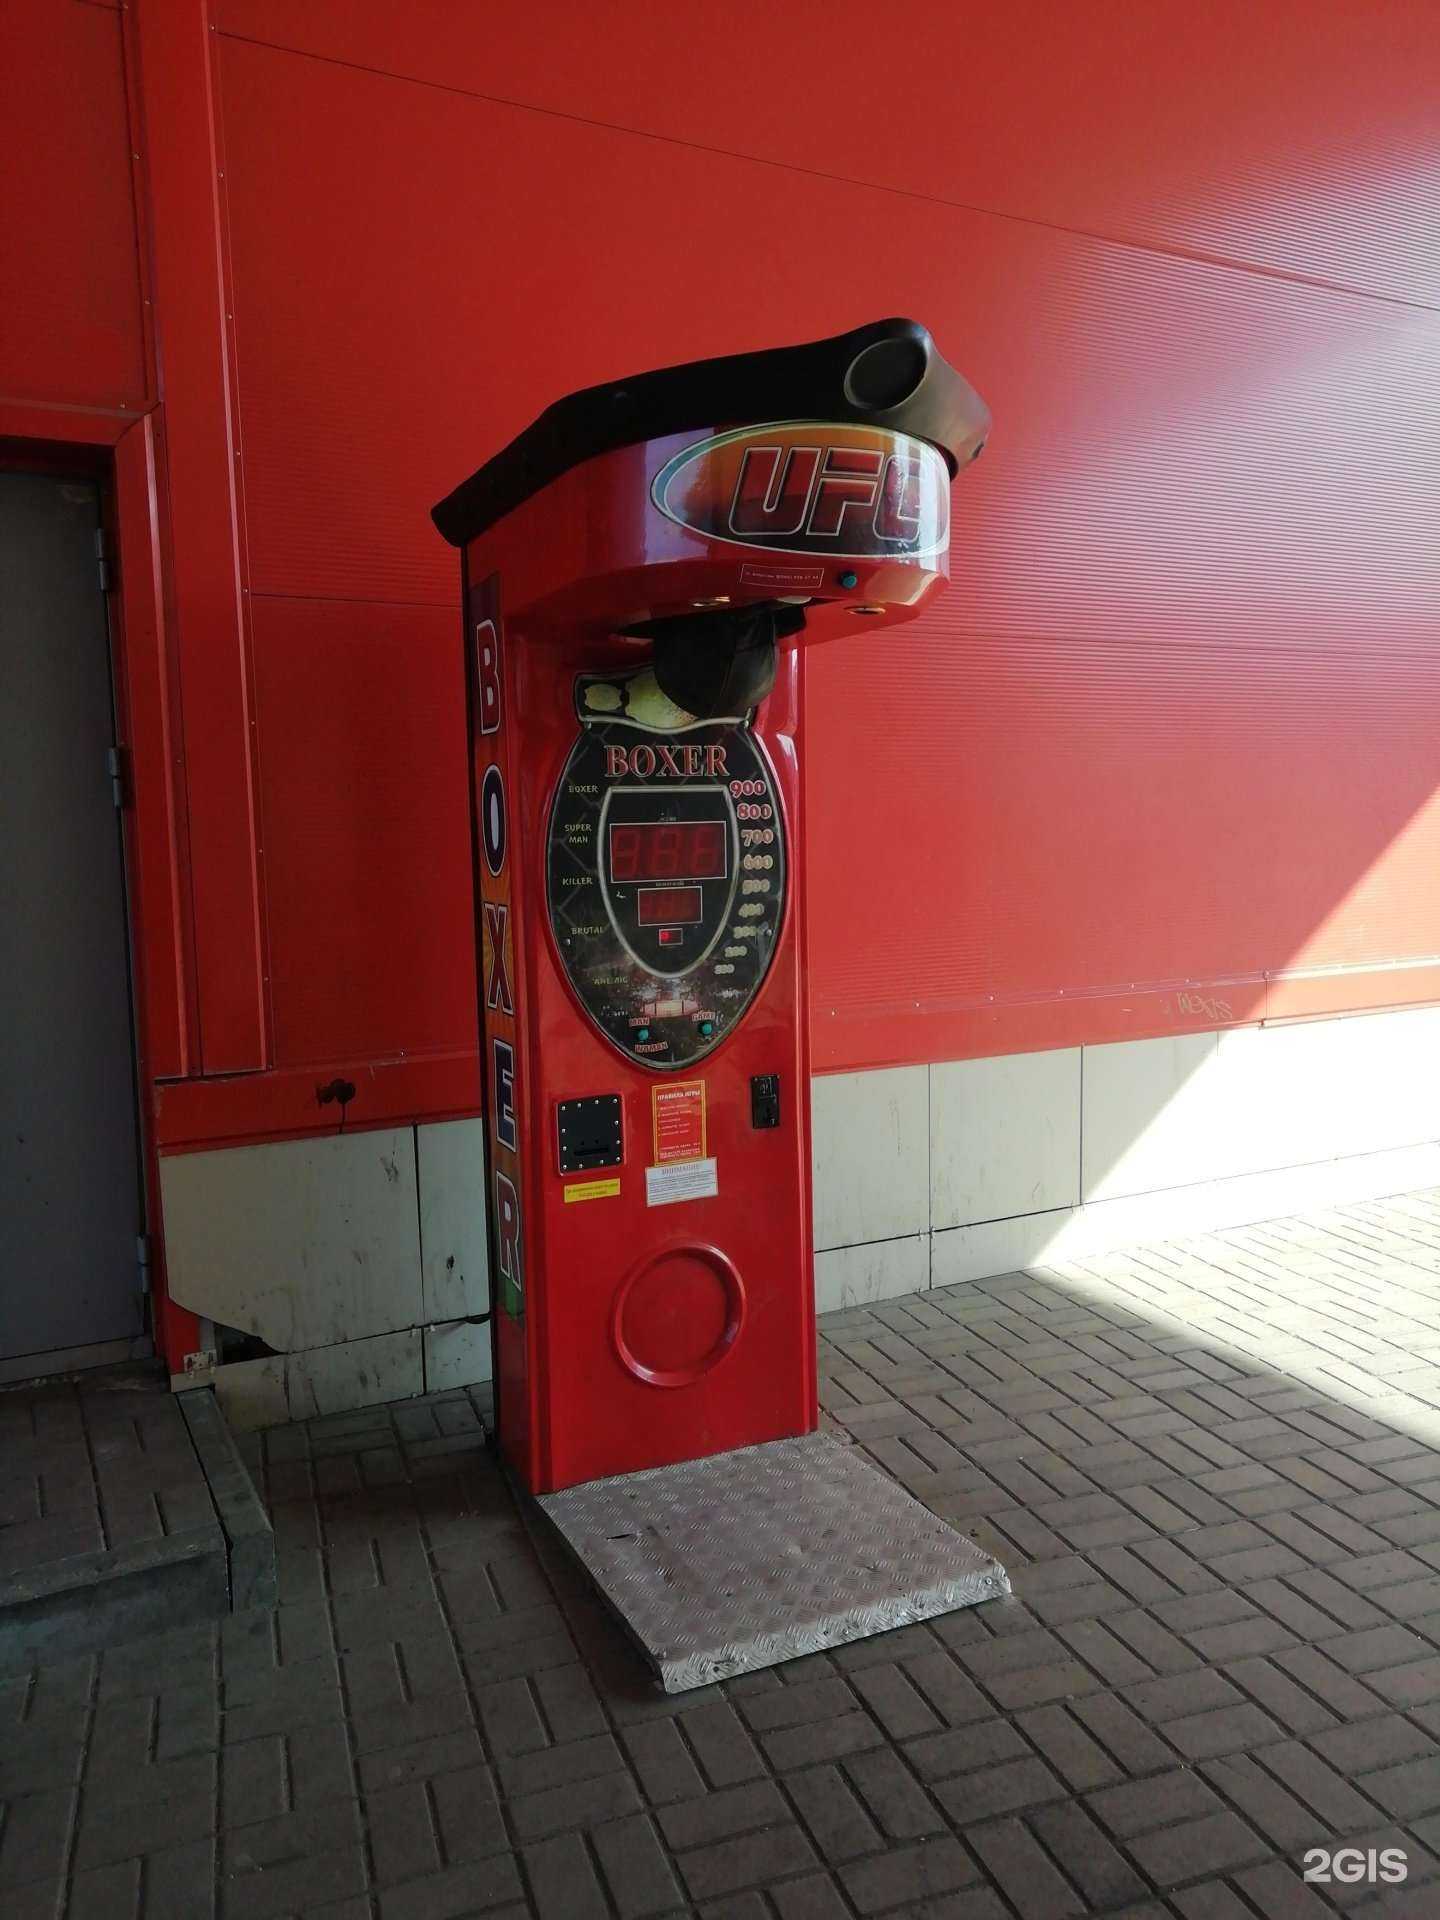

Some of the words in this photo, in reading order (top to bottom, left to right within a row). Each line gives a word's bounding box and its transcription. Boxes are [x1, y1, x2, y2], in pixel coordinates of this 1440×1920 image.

[728, 446, 922, 542] UFC
[604, 744, 730, 778] BOXER
[568, 784, 599, 794] BOXER
[729, 780, 767, 798] 900
[737, 803, 772, 820] 800
[564, 823, 593, 833] SUPER
[568, 836, 588, 844] MAN
[740, 829, 774, 846] 700
[562, 876, 593, 887] KILLER
[571, 926, 604, 936] BRUTAL
[475, 618, 523, 1292] BOXER
